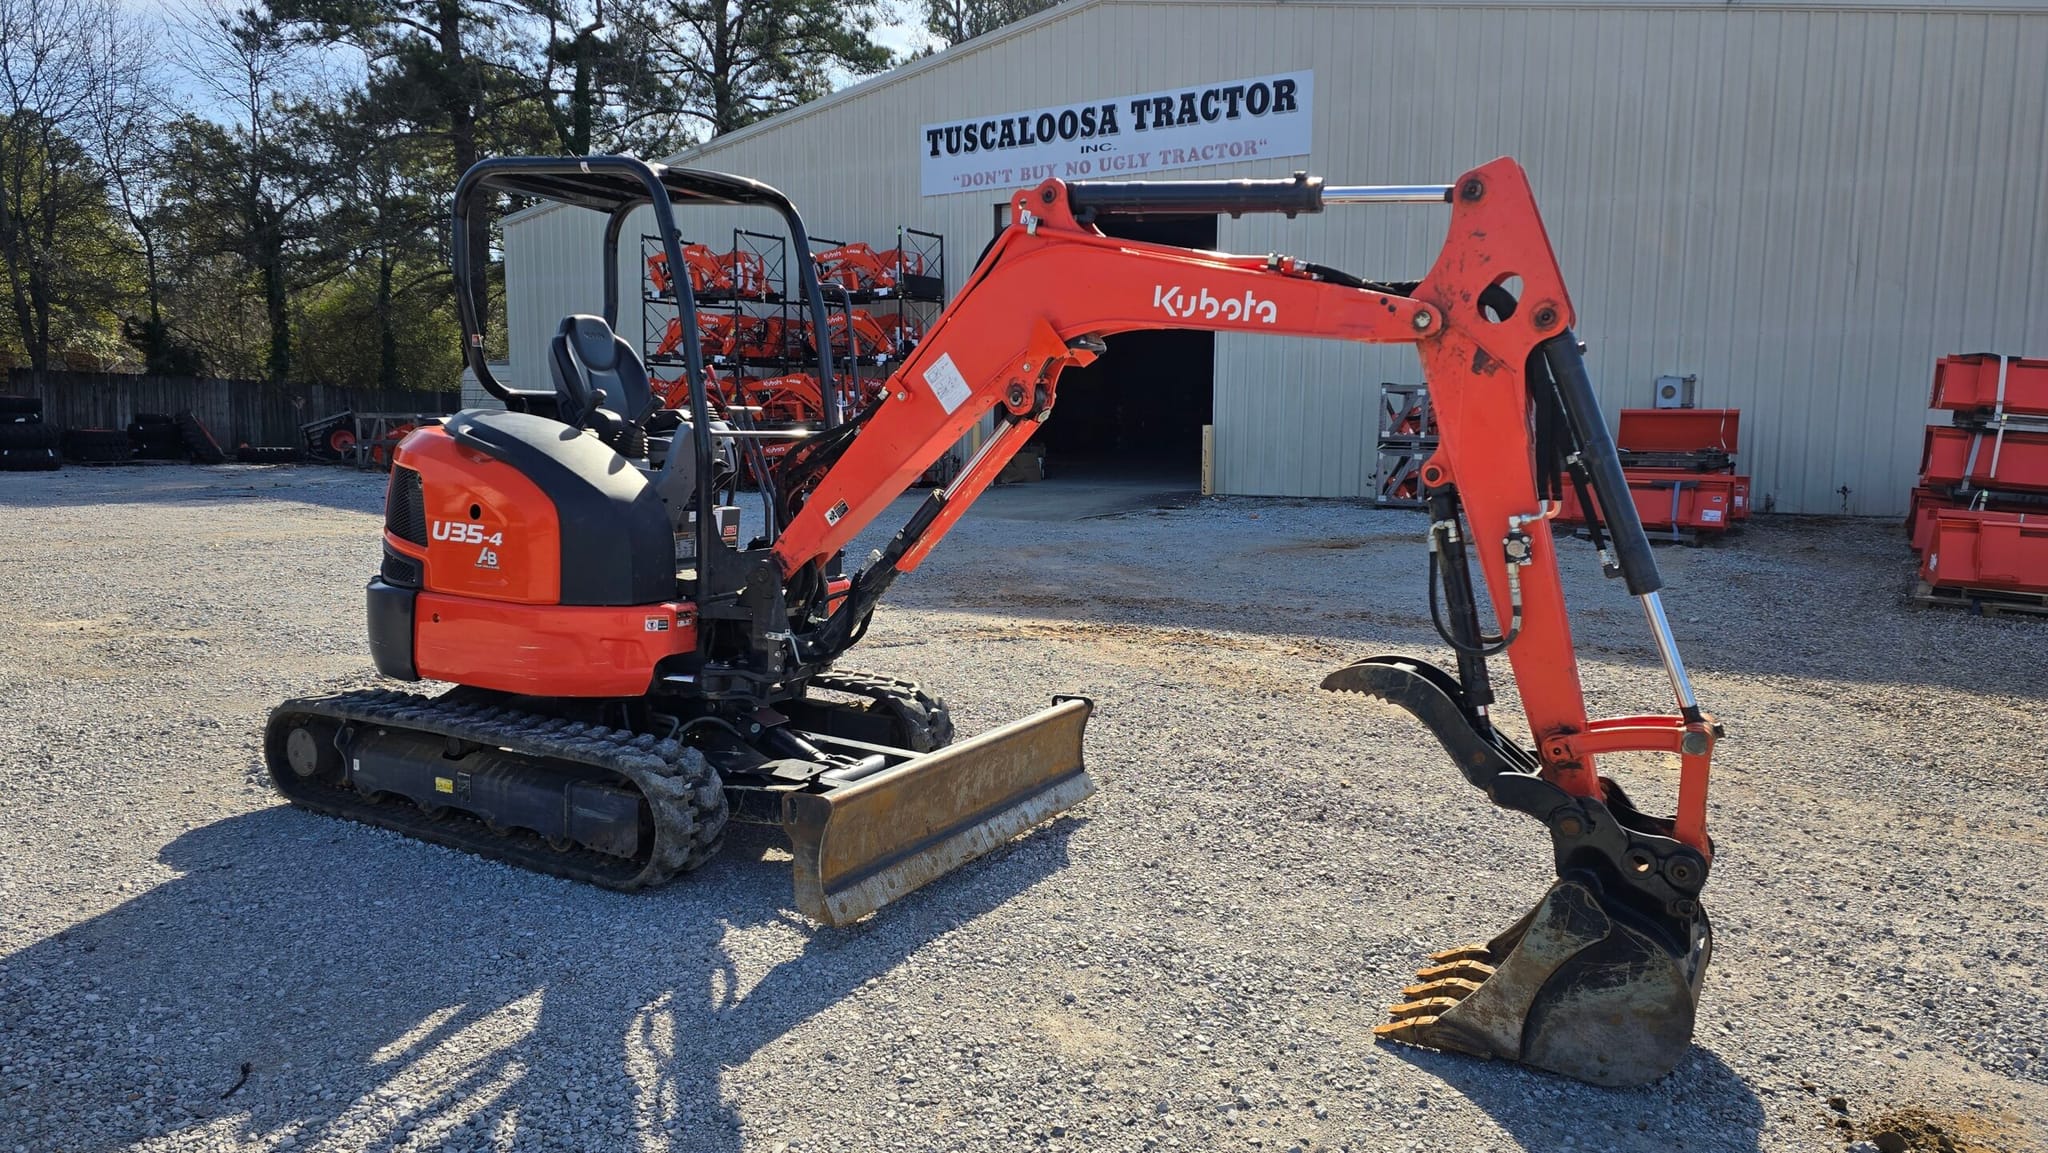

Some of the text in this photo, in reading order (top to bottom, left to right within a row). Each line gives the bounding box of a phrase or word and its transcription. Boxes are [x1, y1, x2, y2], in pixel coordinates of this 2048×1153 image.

[926, 78, 1299, 157] TUSCALOOSA TRACTOR
[1080, 142, 1117, 154] INC.
[1020, 163, 1058, 182] BUY
[1066, 158, 1092, 176] NO
[1099, 152, 1152, 172] UGLY
[1153, 284, 1278, 324] Kubota
[432, 520, 503, 546] U35-4
